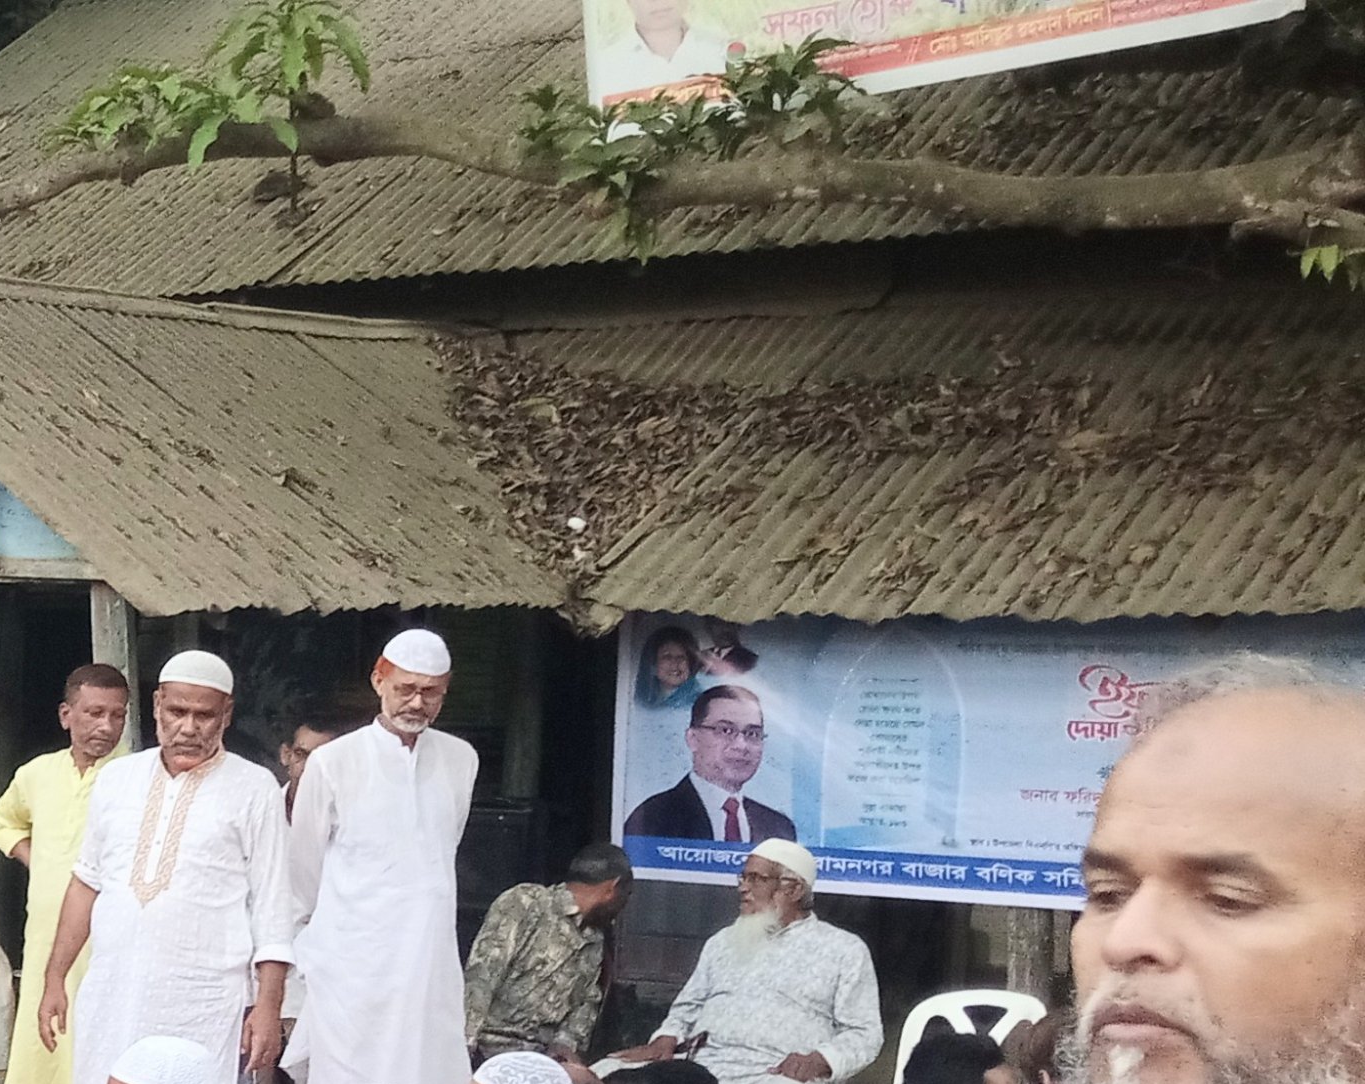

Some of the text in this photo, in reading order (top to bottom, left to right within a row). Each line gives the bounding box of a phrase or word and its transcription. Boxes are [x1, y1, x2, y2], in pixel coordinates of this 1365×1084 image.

[901, 861, 968, 882] বাজার
[975, 862, 1037, 886] বণিক
[1042, 866, 1085, 889] সমি
